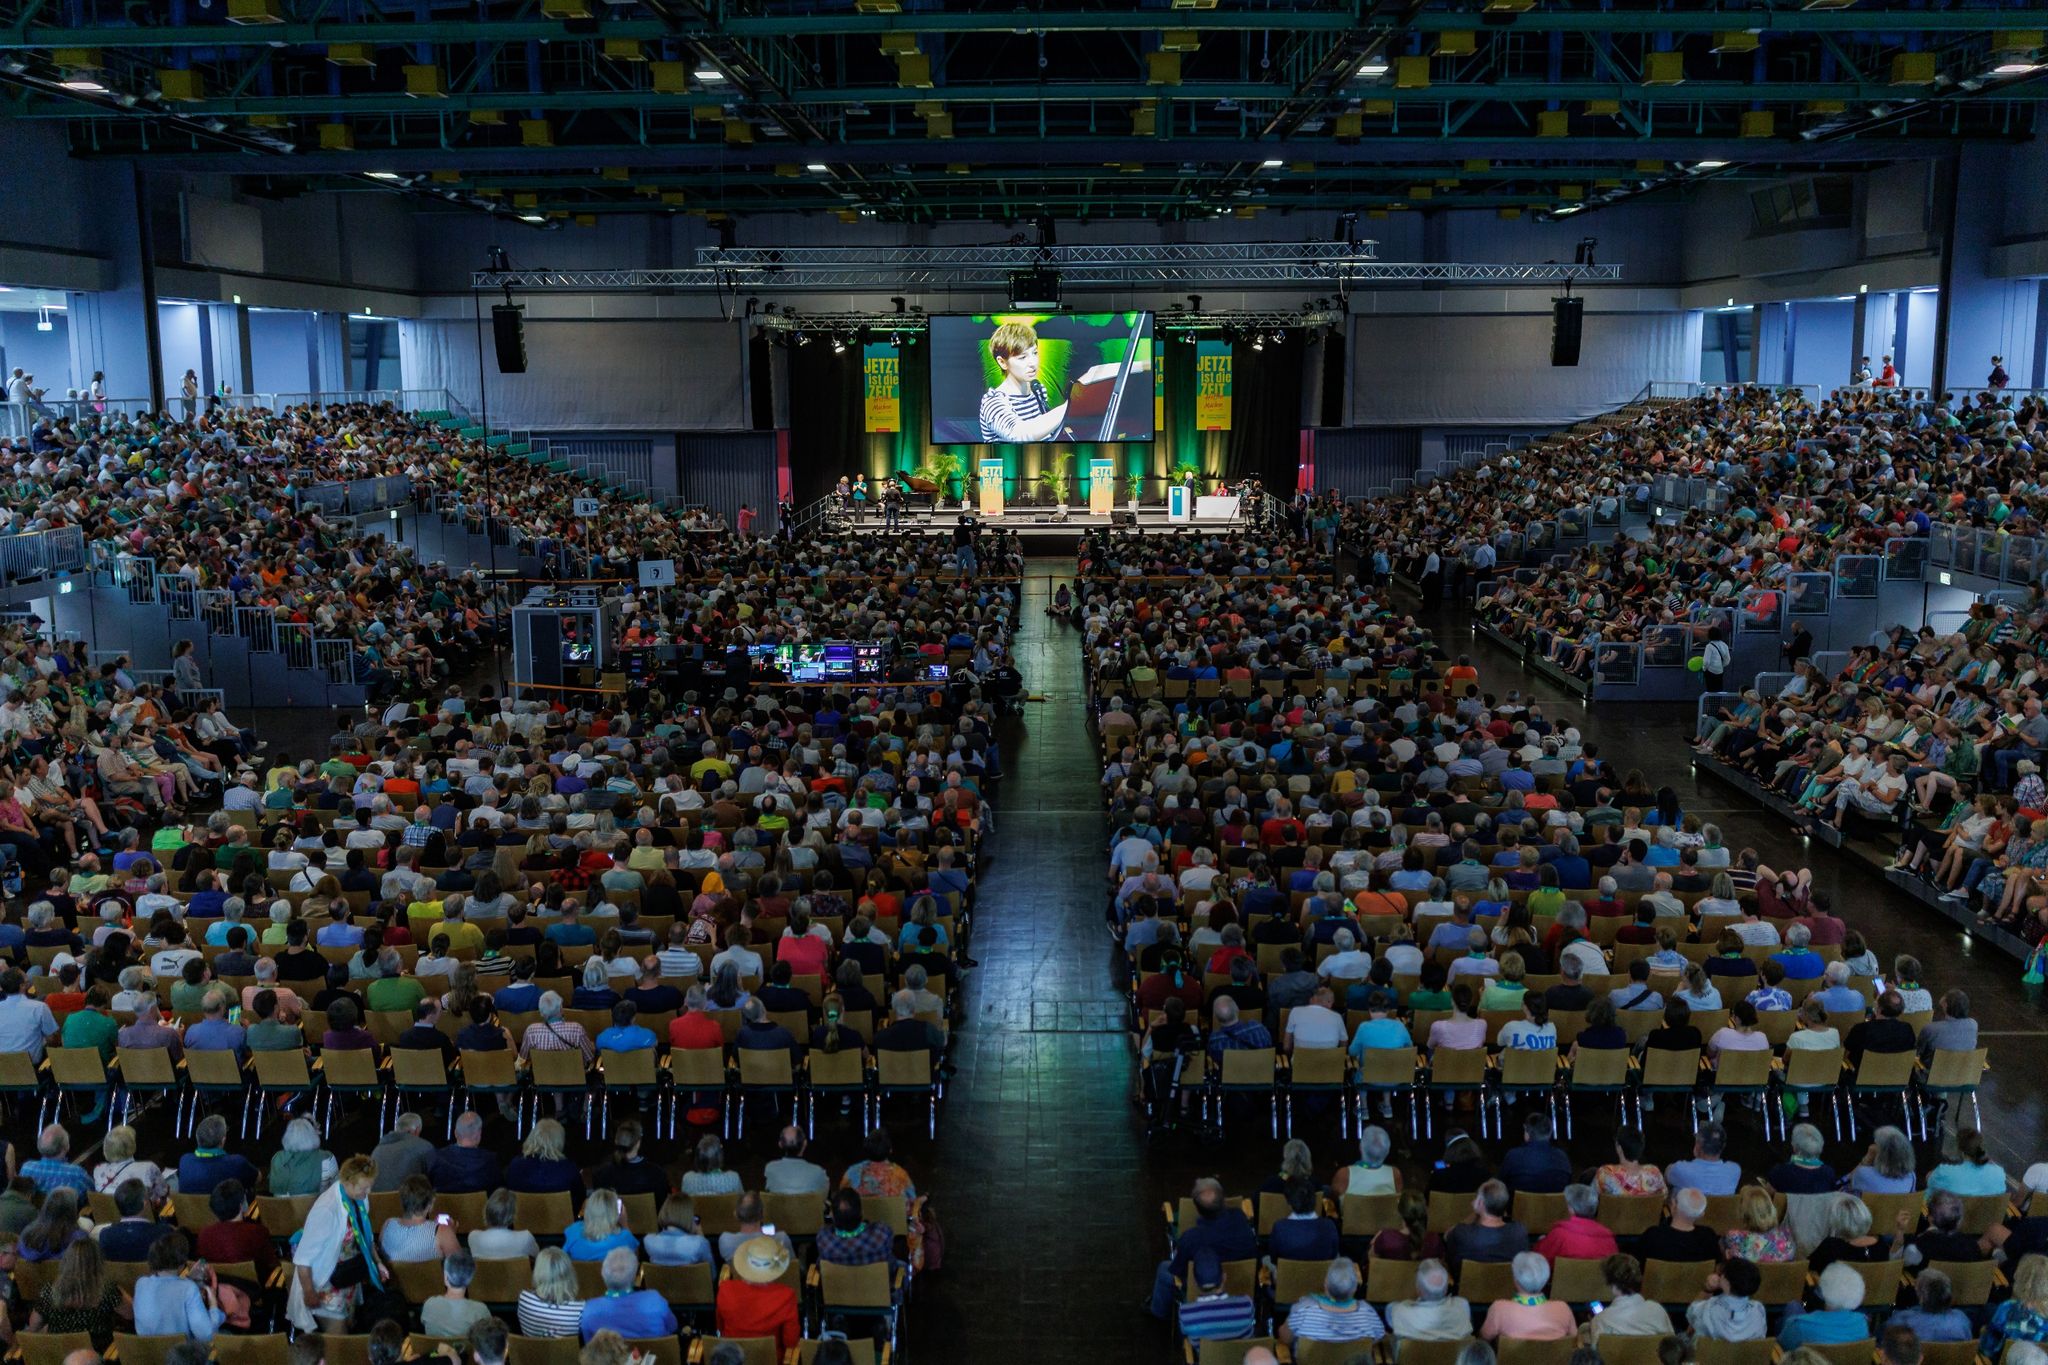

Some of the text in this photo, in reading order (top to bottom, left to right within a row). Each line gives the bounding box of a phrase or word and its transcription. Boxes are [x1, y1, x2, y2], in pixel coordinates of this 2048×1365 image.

[864, 358, 899, 374] JETZT
[1197, 356, 1232, 372] JETZT
[869, 373, 899, 385] ist die
[1201, 371, 1231, 383] ist die
[869, 385, 892, 398] ZEIT
[1201, 383, 1224, 396] ZEIT
